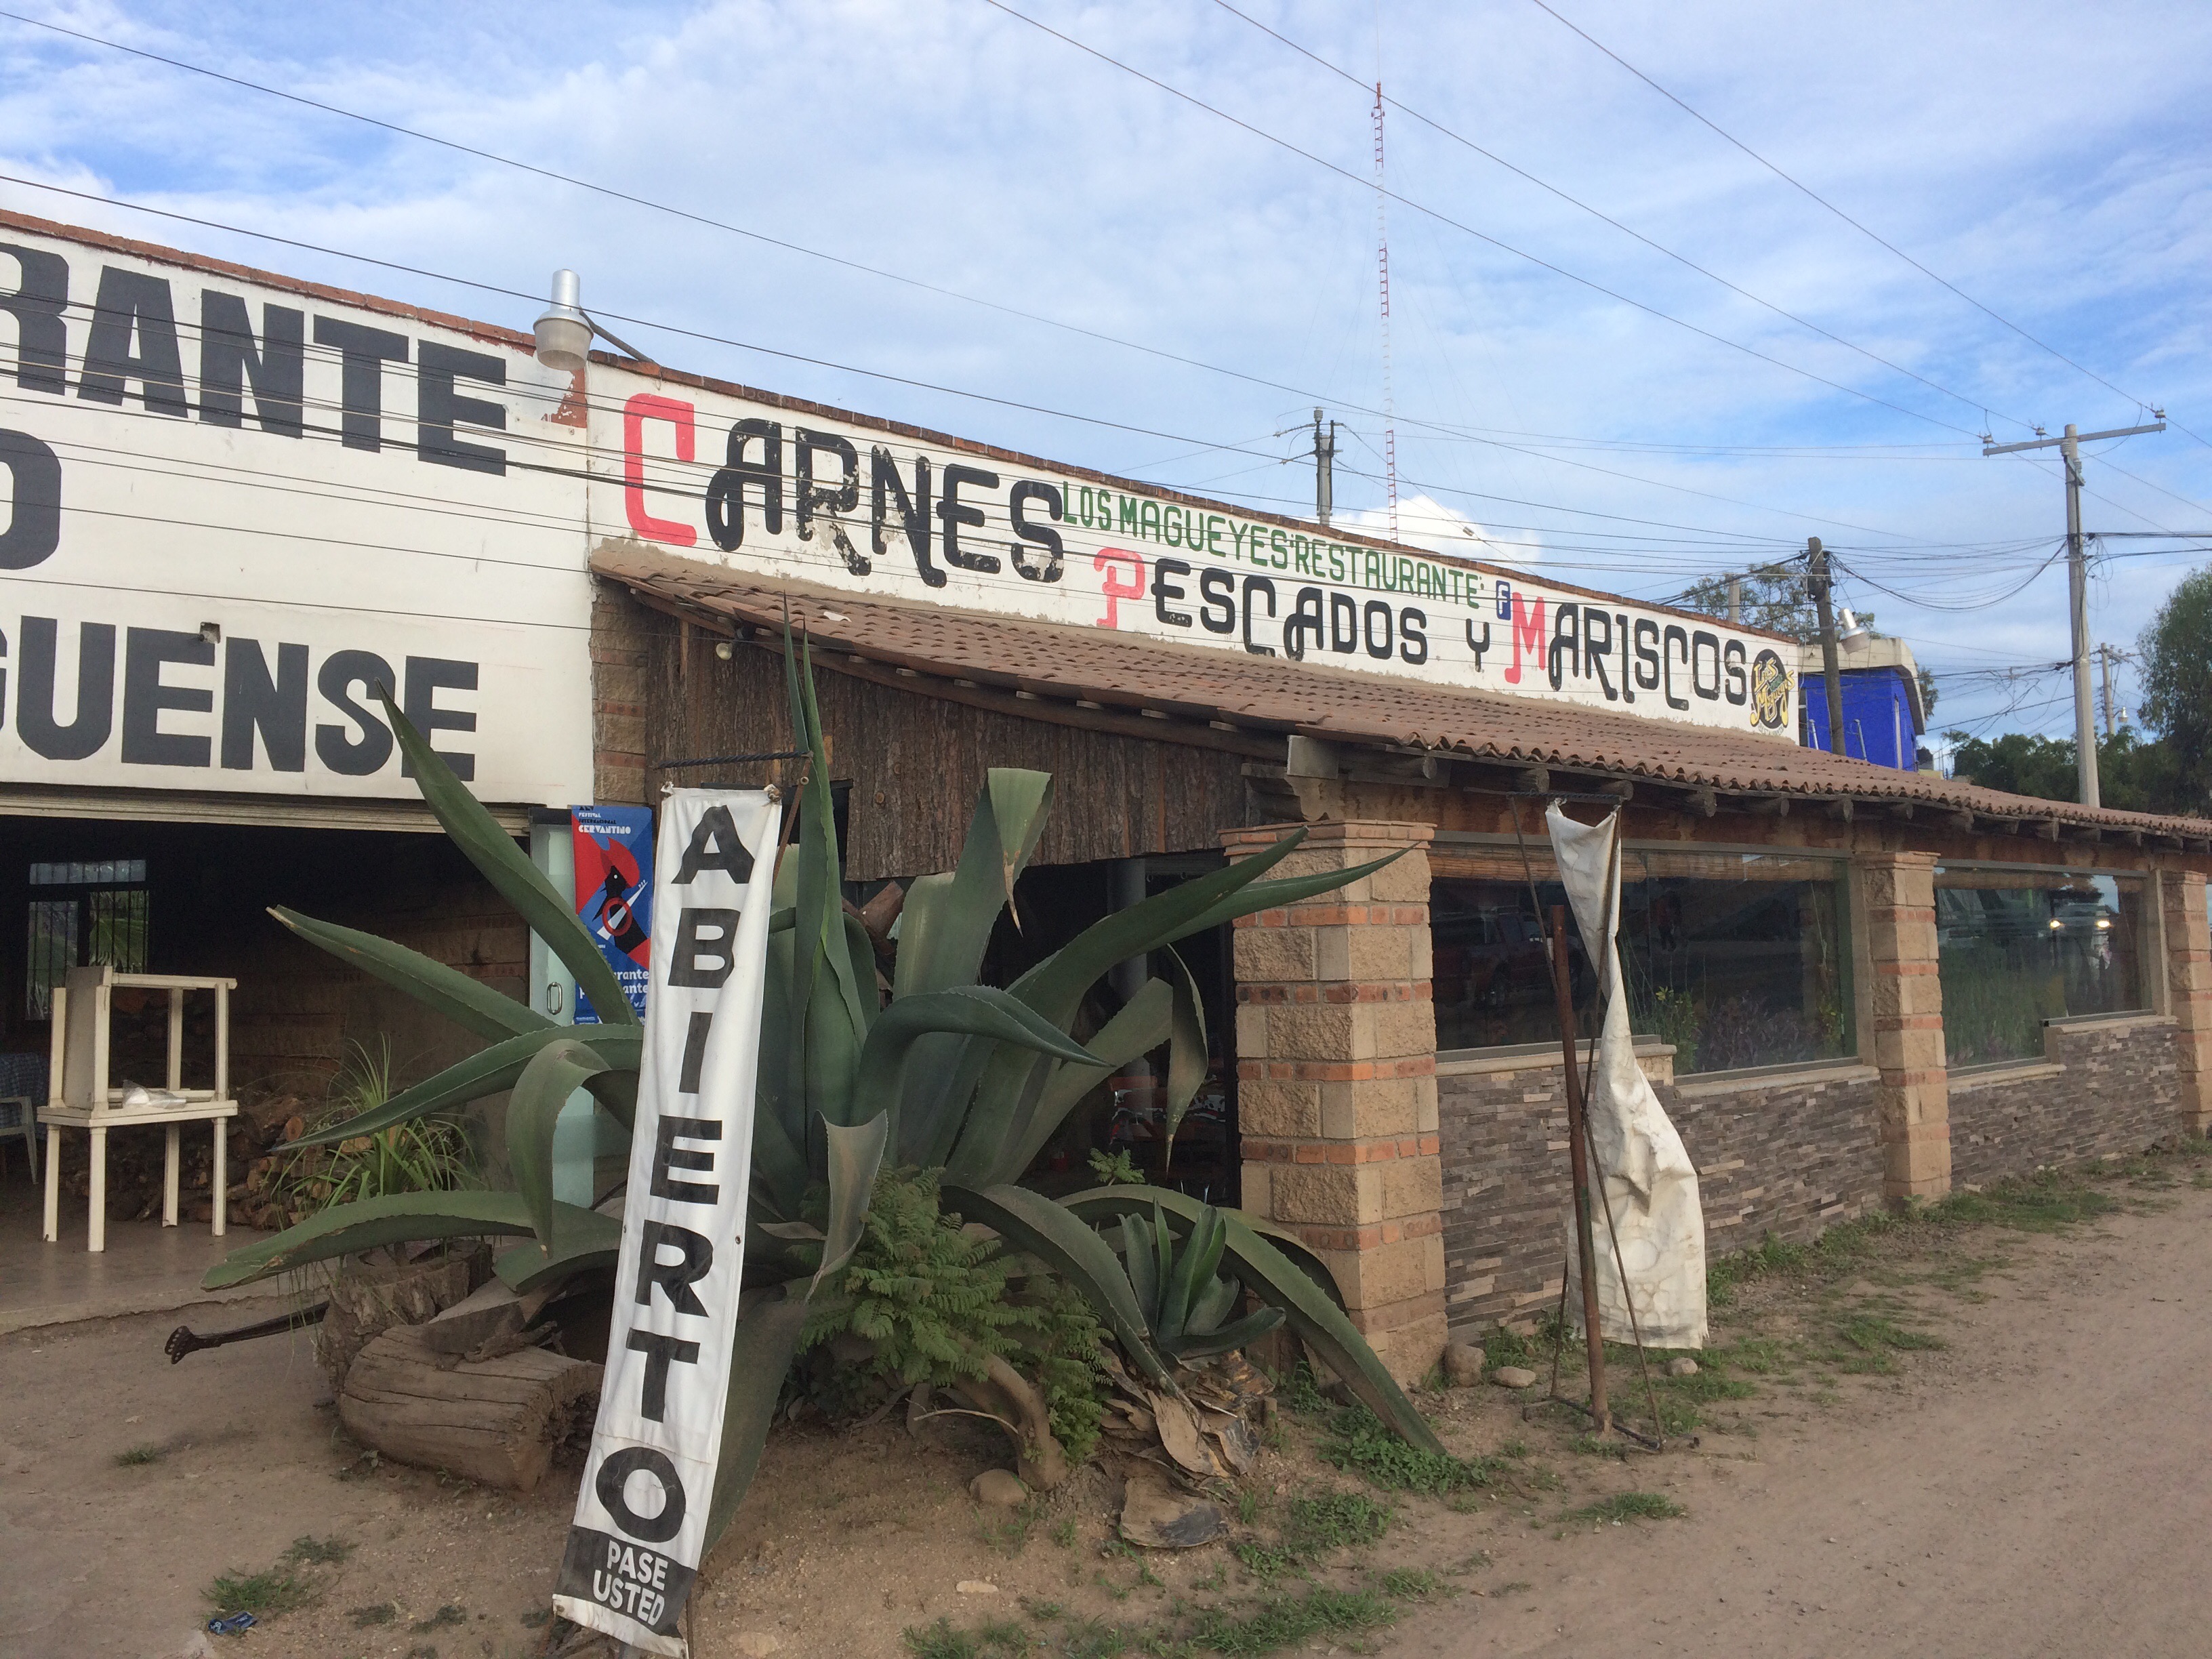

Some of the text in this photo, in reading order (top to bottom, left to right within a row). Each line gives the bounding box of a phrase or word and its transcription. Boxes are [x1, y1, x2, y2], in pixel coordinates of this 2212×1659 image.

[623, 393, 1064, 587] CARNES
[1062, 481, 1111, 531] LOS
[1120, 493, 1287, 570] MAGUEYES
[1093, 548, 1747, 711] PESCADOS Y MARISCOS
[0, 615, 479, 782] UENSE
[578, 825, 631, 834] CERVANTINO
[595, 804, 755, 1543] ABIERTO
[593, 1570, 665, 1626] USTED
[607, 1540, 668, 1591] PASE
